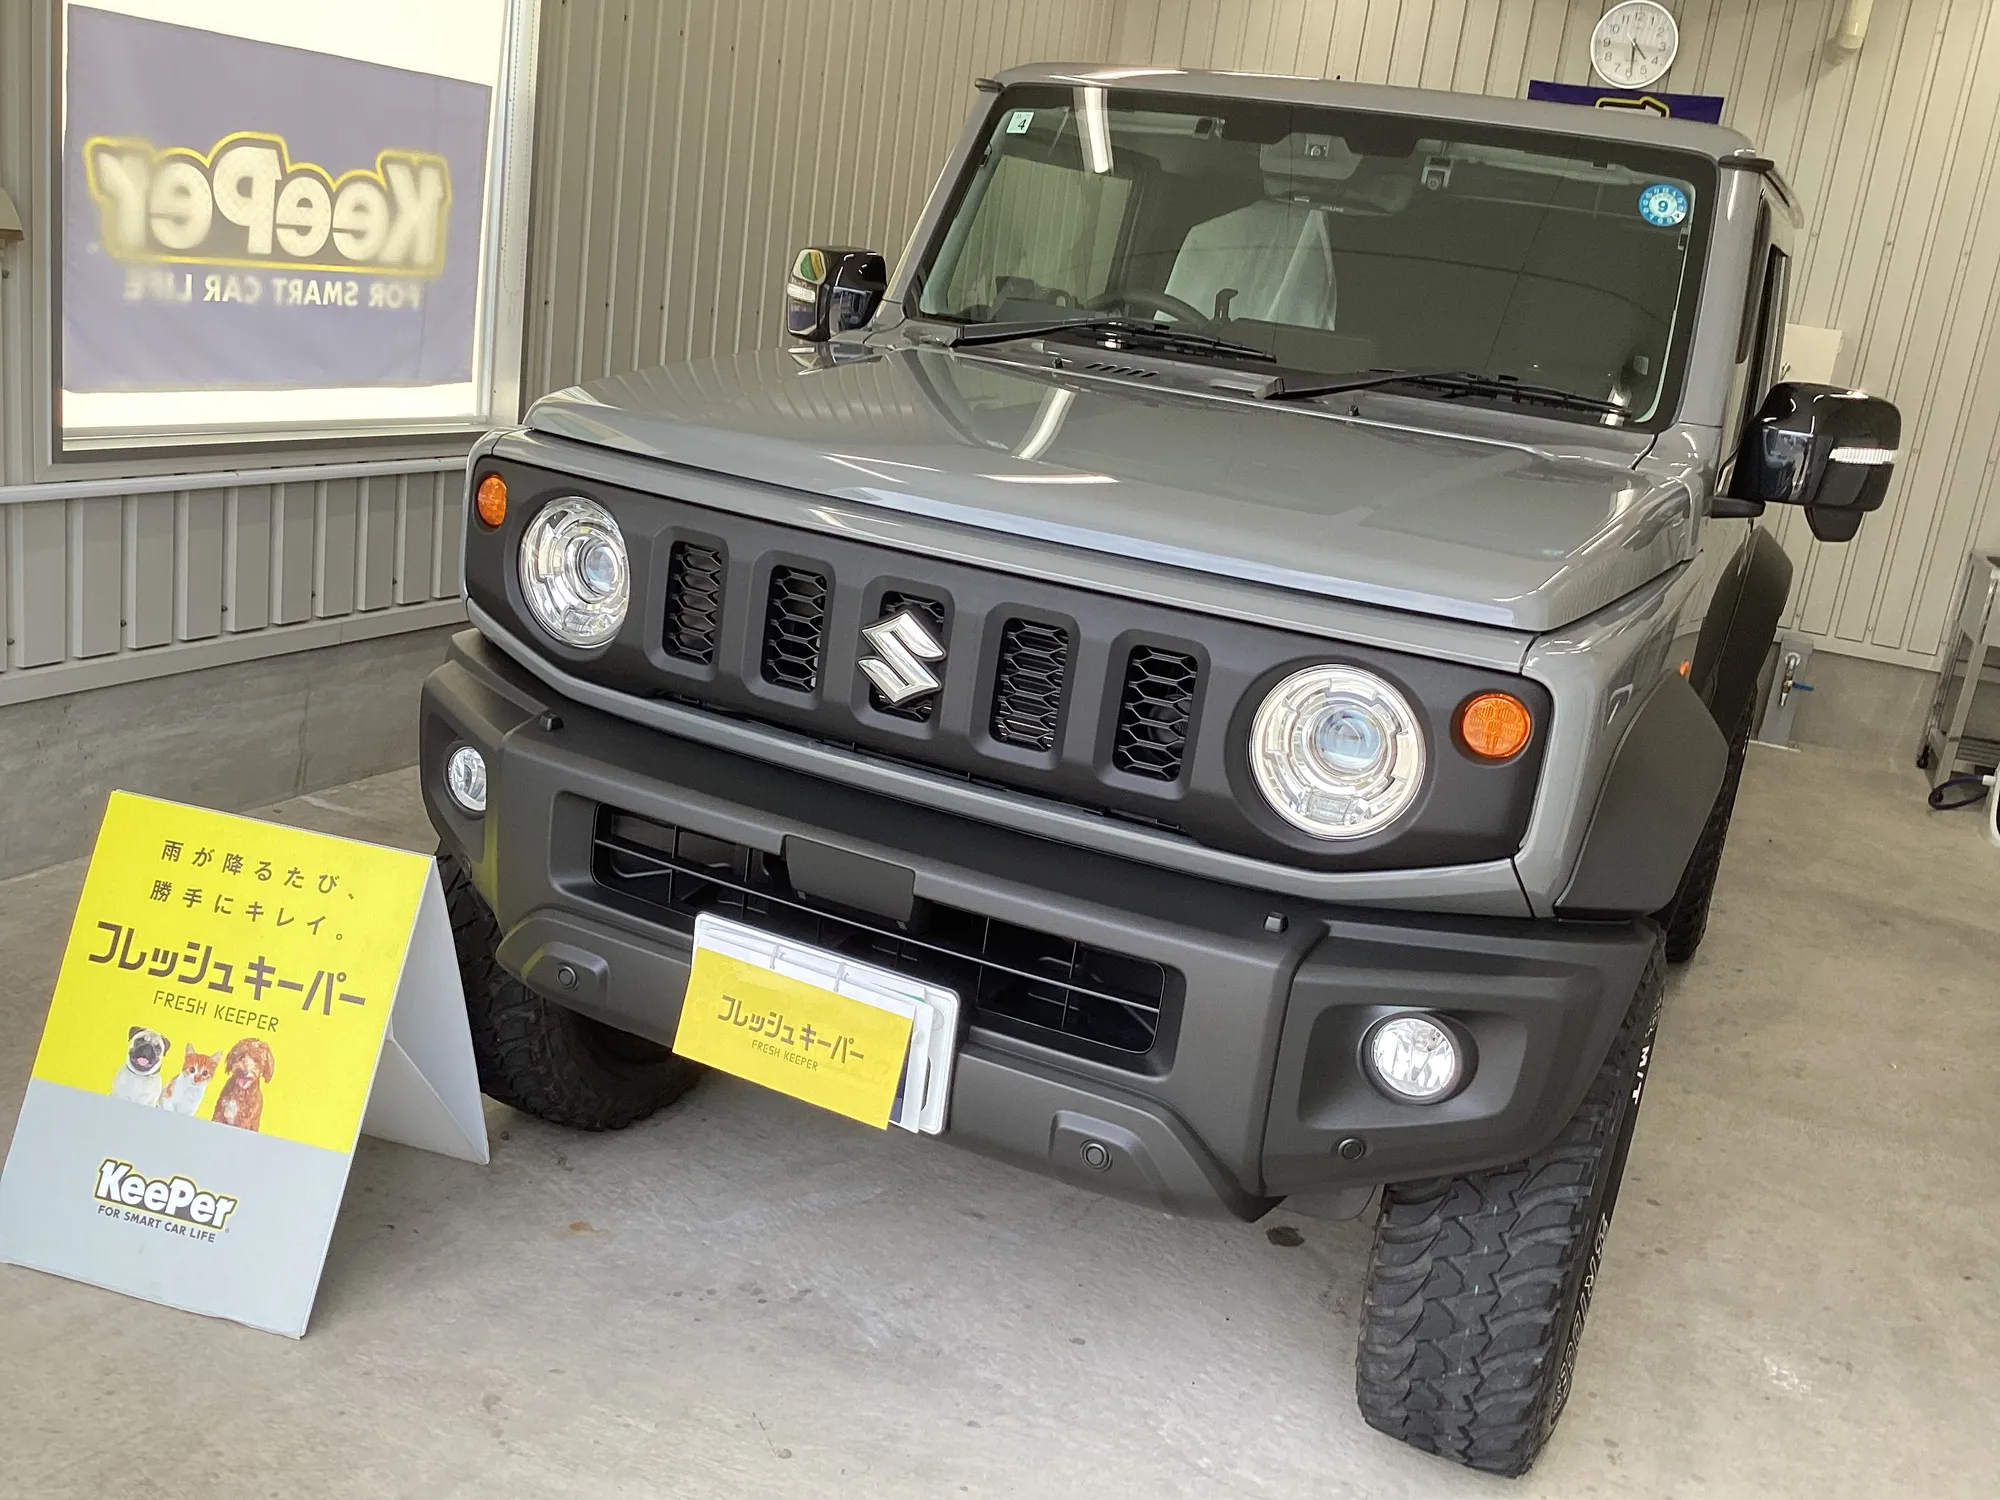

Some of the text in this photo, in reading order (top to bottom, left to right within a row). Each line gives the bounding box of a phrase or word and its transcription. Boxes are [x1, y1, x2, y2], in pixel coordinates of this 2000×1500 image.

[1018, 119, 1027, 130] 4
[1658, 200, 1669, 213] 9
[161, 839, 355, 900] 雨が降るたび、
[150, 879, 343, 941] 勝手にキレイ。
[88, 920, 366, 1016] フレッシュキーパー
[153, 990, 280, 1033] FRESH KEEPER
[717, 994, 865, 1064] フレッシュキーパー
[751, 1039, 819, 1071] FRESH KEEPER
[95, 1159, 237, 1228] KeePer
[97, 1205, 216, 1243] FOR SMART CAR LIFE
